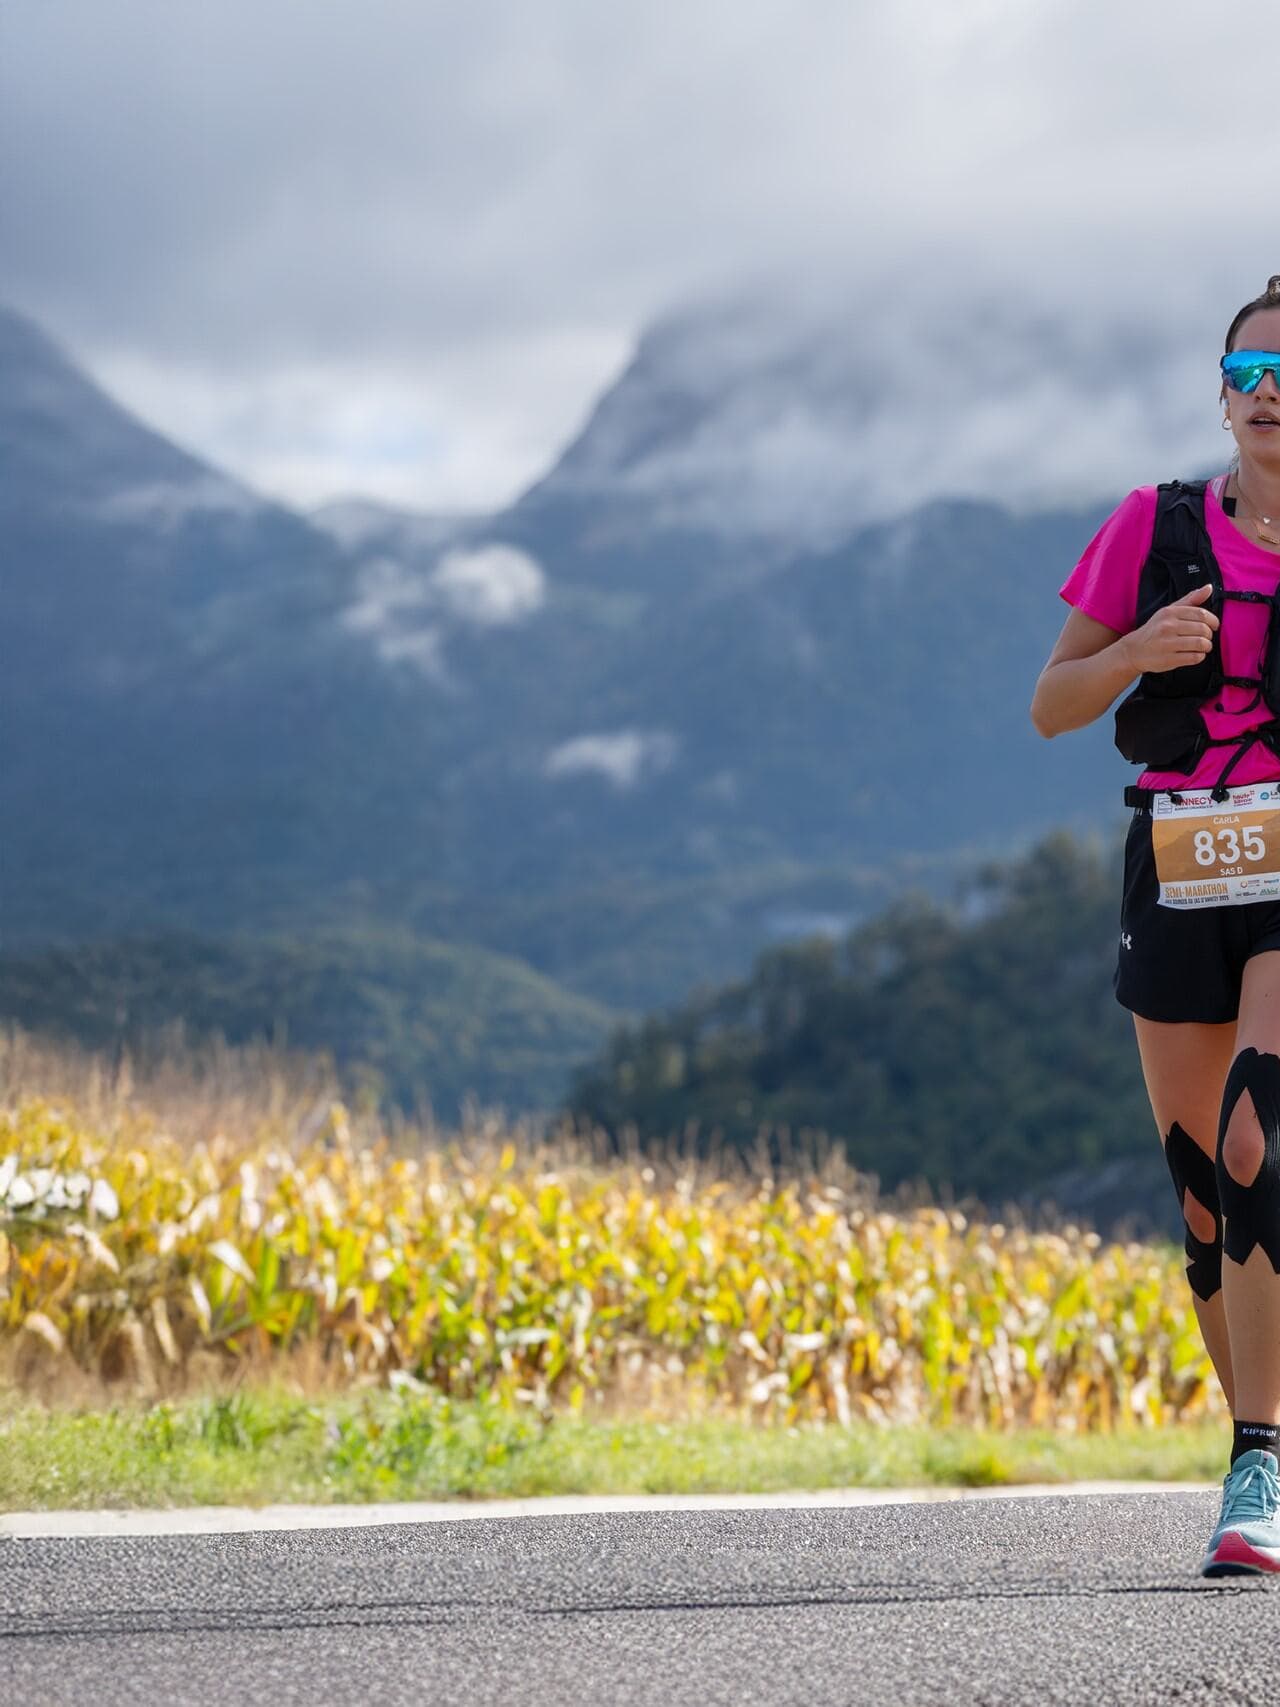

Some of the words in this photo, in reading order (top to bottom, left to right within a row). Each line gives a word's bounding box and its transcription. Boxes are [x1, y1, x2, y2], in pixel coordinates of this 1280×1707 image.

[1175, 797, 1213, 806] NNECY
[1213, 815, 1240, 825] CARLA
[1194, 825, 1265, 866] 835
[1220, 867, 1236, 876] SAS
[1237, 866, 1243, 874] D
[1165, 883, 1229, 898] SEMI-MARATHON
[1242, 1427, 1277, 1437] KIPRUN
